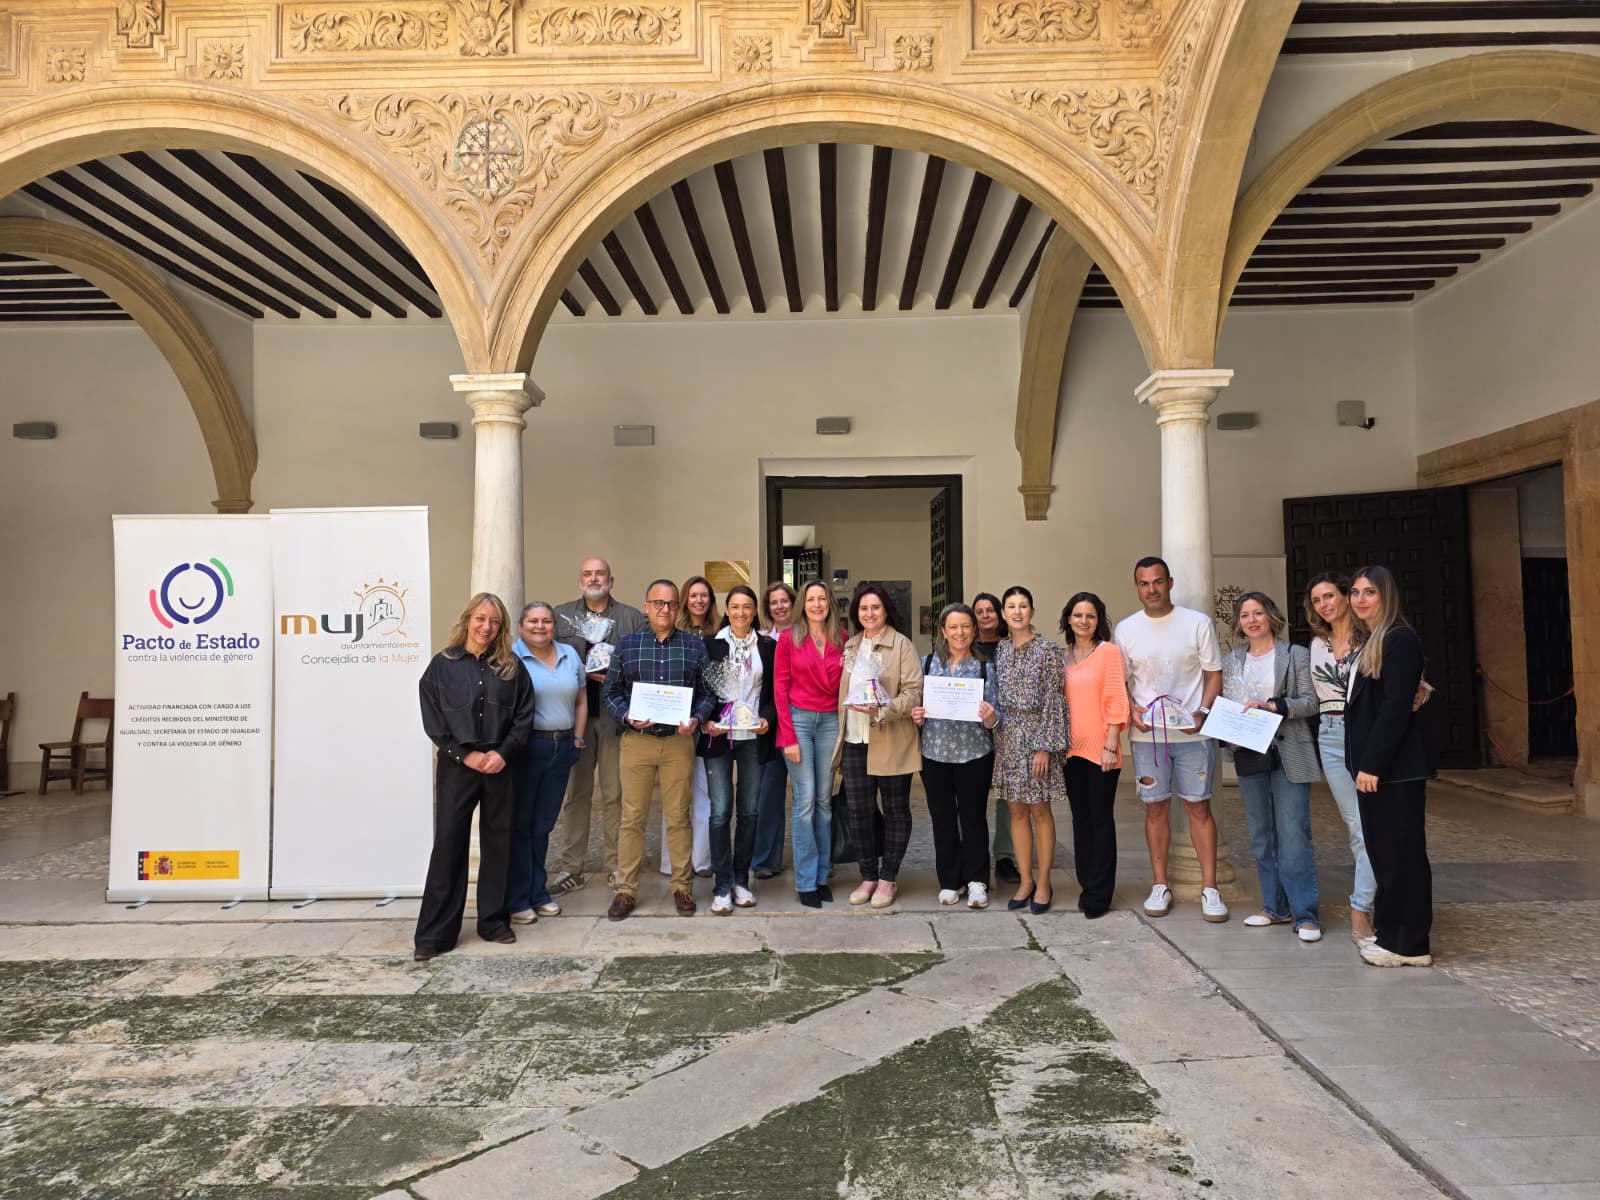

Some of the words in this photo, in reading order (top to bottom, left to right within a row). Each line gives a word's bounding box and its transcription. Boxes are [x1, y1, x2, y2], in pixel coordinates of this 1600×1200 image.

[122, 634, 175, 650] Pacto
[179, 640, 192, 650] de
[196, 633, 260, 649] Estado
[128, 654, 157, 662] contra
[159, 653, 168, 662] la
[169, 653, 208, 662] violencia
[209, 653, 221, 661] de
[223, 652, 253, 663] género
[362, 653, 376, 663] de
[379, 653, 388, 663] la
[391, 653, 420, 665] Mujer
